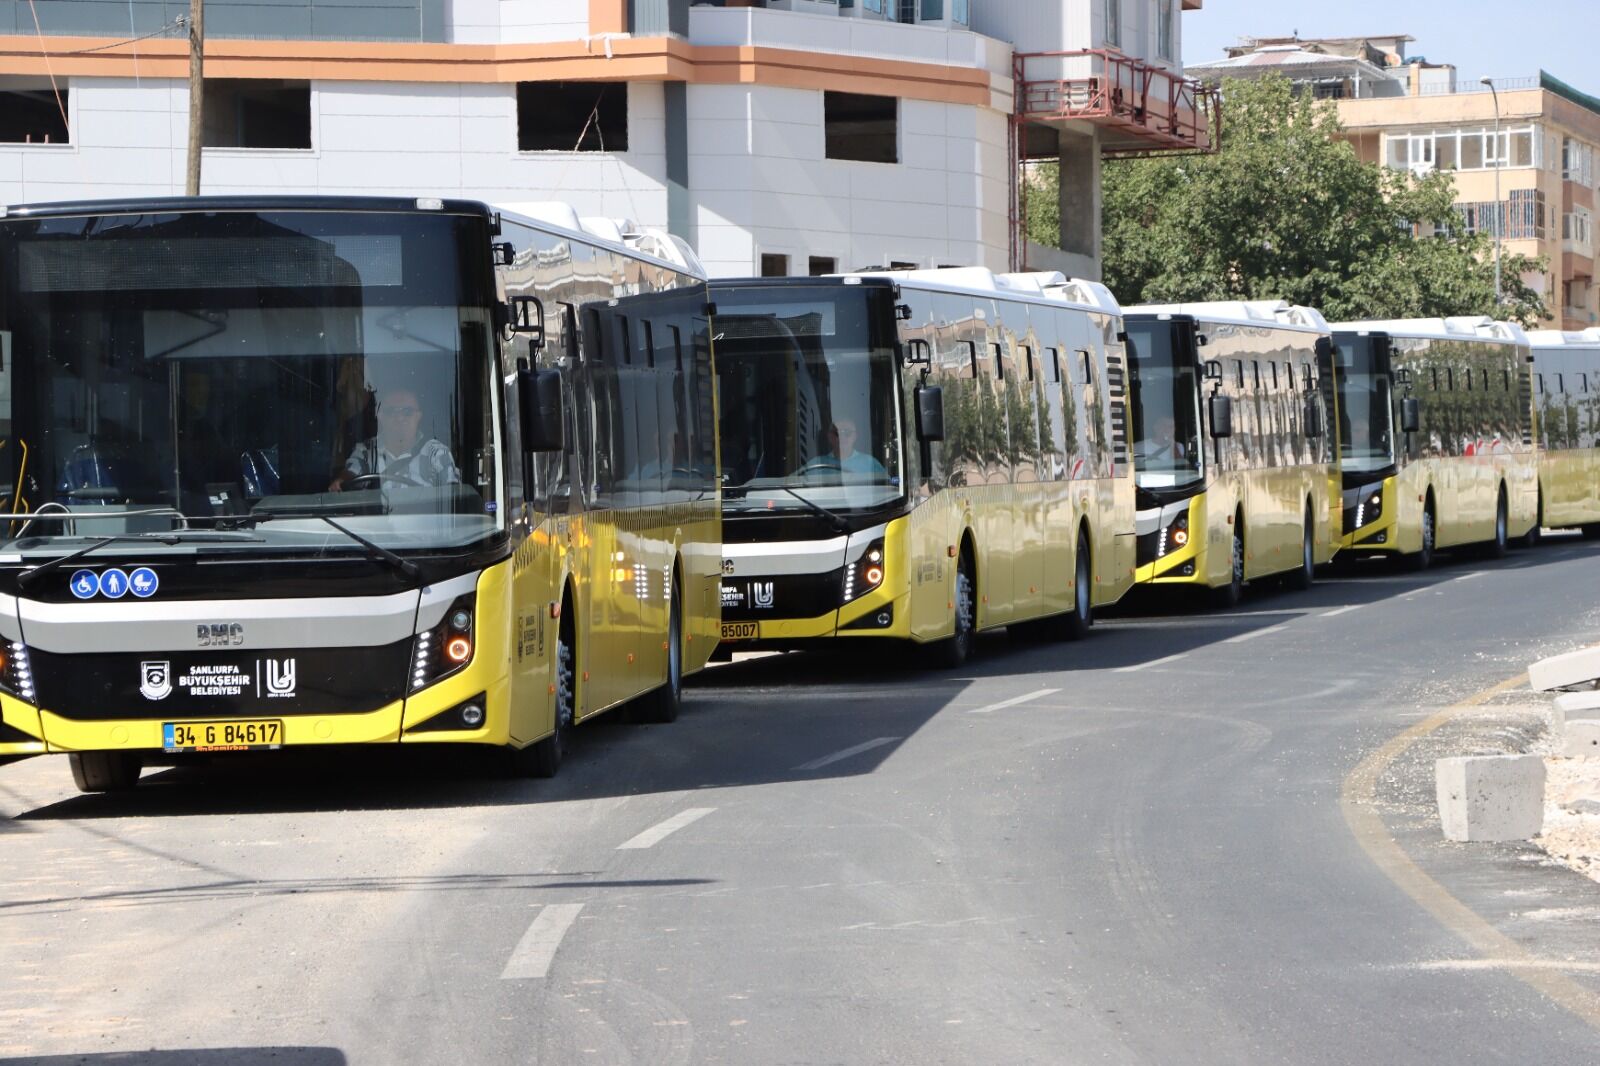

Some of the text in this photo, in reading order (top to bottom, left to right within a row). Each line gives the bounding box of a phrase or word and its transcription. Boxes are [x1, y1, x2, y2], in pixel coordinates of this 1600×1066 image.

[197, 623, 244, 646] BMC
[721, 624, 756, 638] 85007
[190, 665, 240, 675] ŞANLIURFA
[179, 675, 250, 687] BÜYÜKŞEHİR
[190, 685, 241, 696] BELEDİYESİ
[175, 723, 278, 744] 34 G 84617
